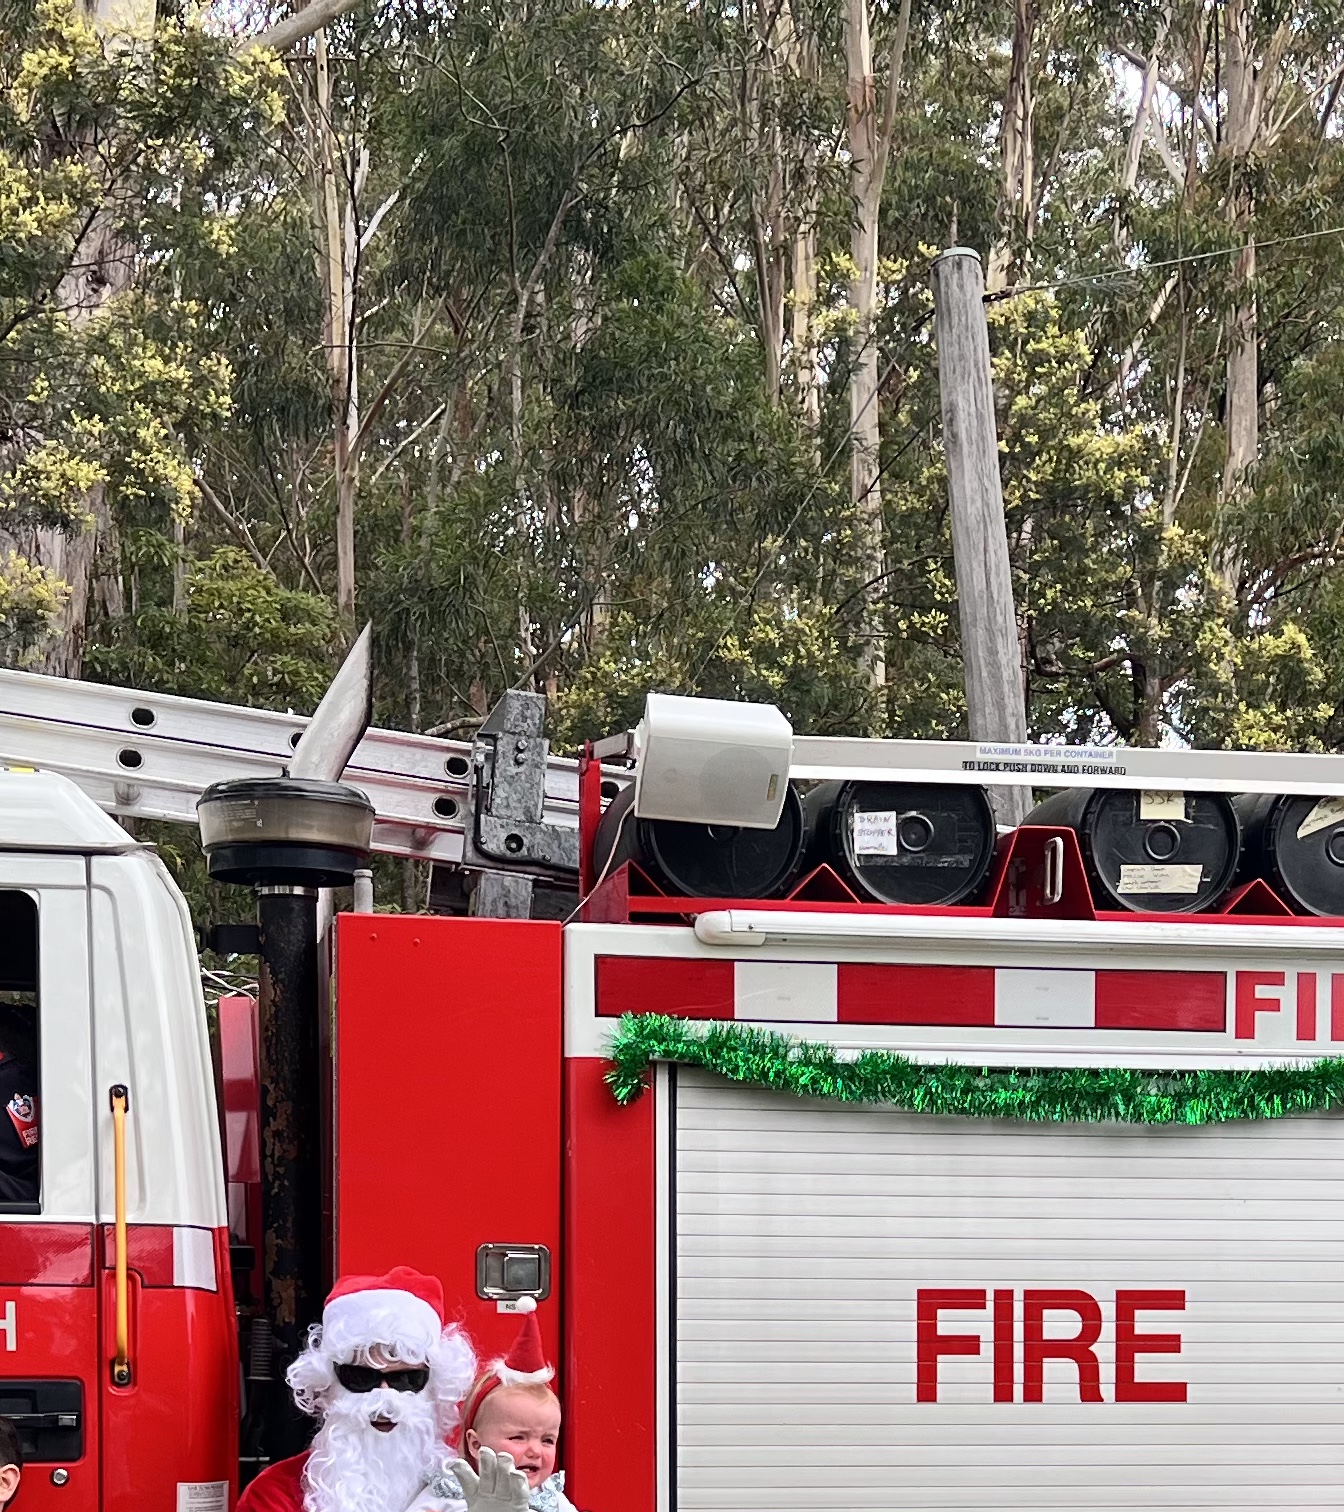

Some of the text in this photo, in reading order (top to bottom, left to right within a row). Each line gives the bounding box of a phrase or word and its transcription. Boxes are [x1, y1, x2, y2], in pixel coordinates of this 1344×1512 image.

[979, 747, 1022, 756] MAXIMUM
[1043, 749, 1062, 757] PER
[1064, 750, 1114, 759] CONTAINER
[976, 761, 1000, 772] LOCK
[1003, 762, 1027, 772] PUSH
[1082, 765, 1126, 775] FORWARD
[916, 1288, 1188, 1403] FIRE
